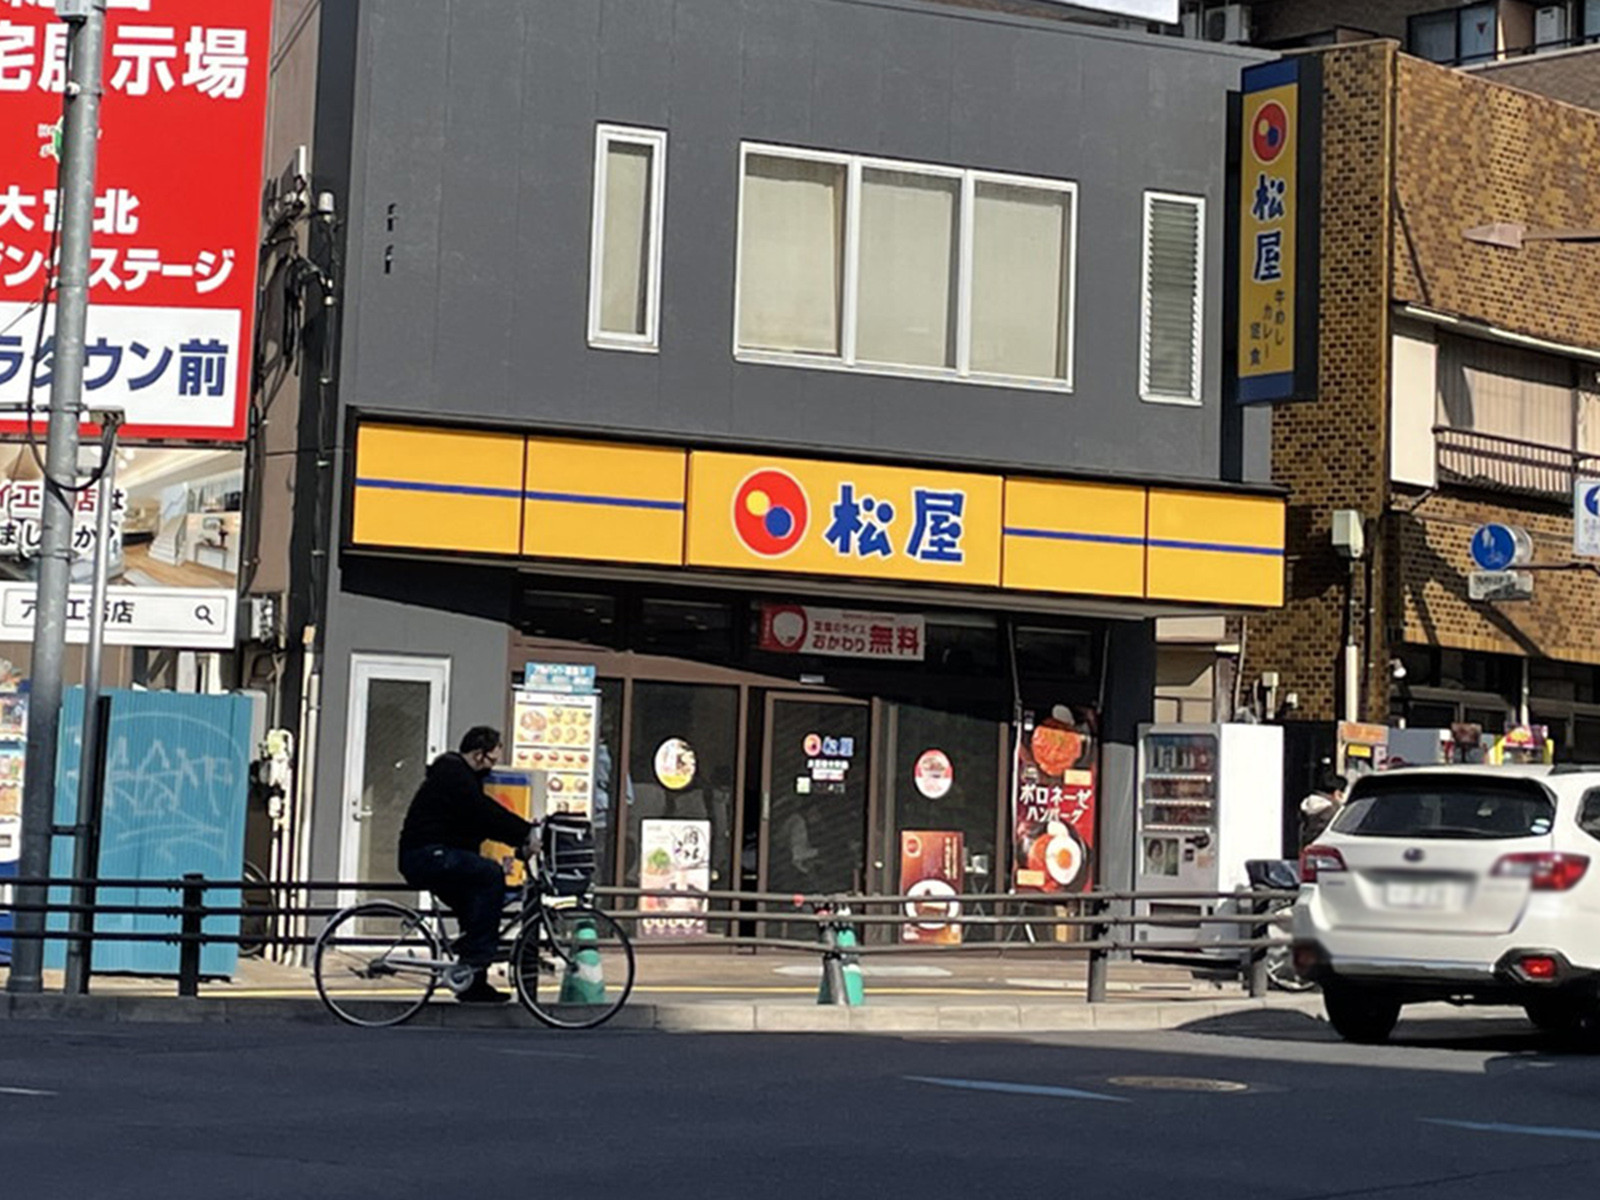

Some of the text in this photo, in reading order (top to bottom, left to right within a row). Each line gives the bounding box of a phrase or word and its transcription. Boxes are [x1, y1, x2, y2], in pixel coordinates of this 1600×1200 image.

[1251, 173, 1285, 284] 松屋
[0, 241, 235, 293] ンステージ
[824, 484, 964, 563] 松屋
[869, 624, 920, 656] 無料
